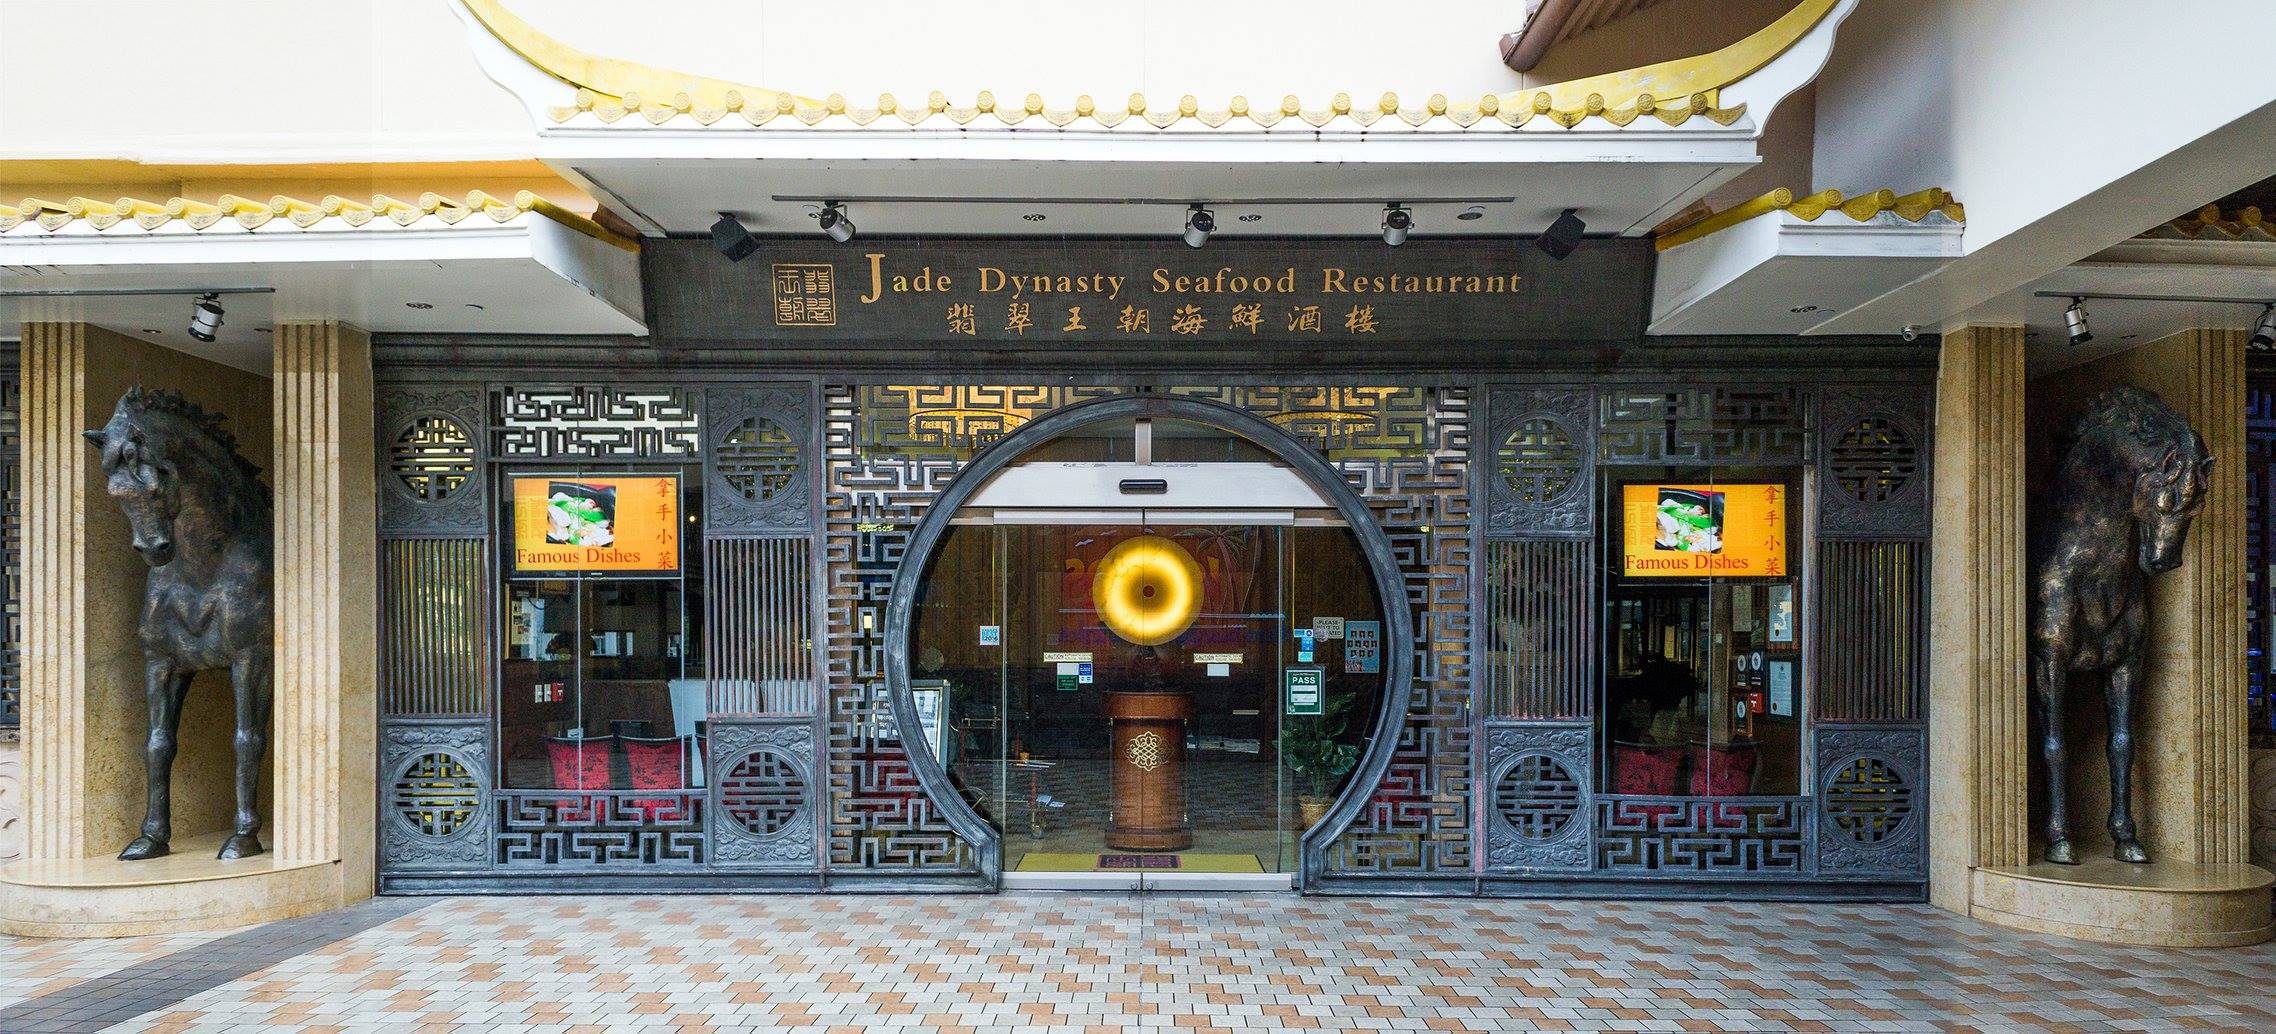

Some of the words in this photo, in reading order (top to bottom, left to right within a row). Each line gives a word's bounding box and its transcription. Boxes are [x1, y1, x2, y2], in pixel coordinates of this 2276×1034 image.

[861, 252, 951, 304] Jade
[978, 267, 1126, 300] Dynasty
[1152, 267, 1296, 293] Seafood
[1322, 268, 1521, 293] Restaurant
[656, 478, 673, 570] 拿手小菜
[1764, 486, 1781, 575] 拿手小菜
[517, 548, 579, 564] Famous
[587, 548, 641, 564] Dishes
[1625, 553, 1689, 570] Famous
[1695, 553, 1749, 570] Dishes
[1292, 676, 1316, 684] PASS
